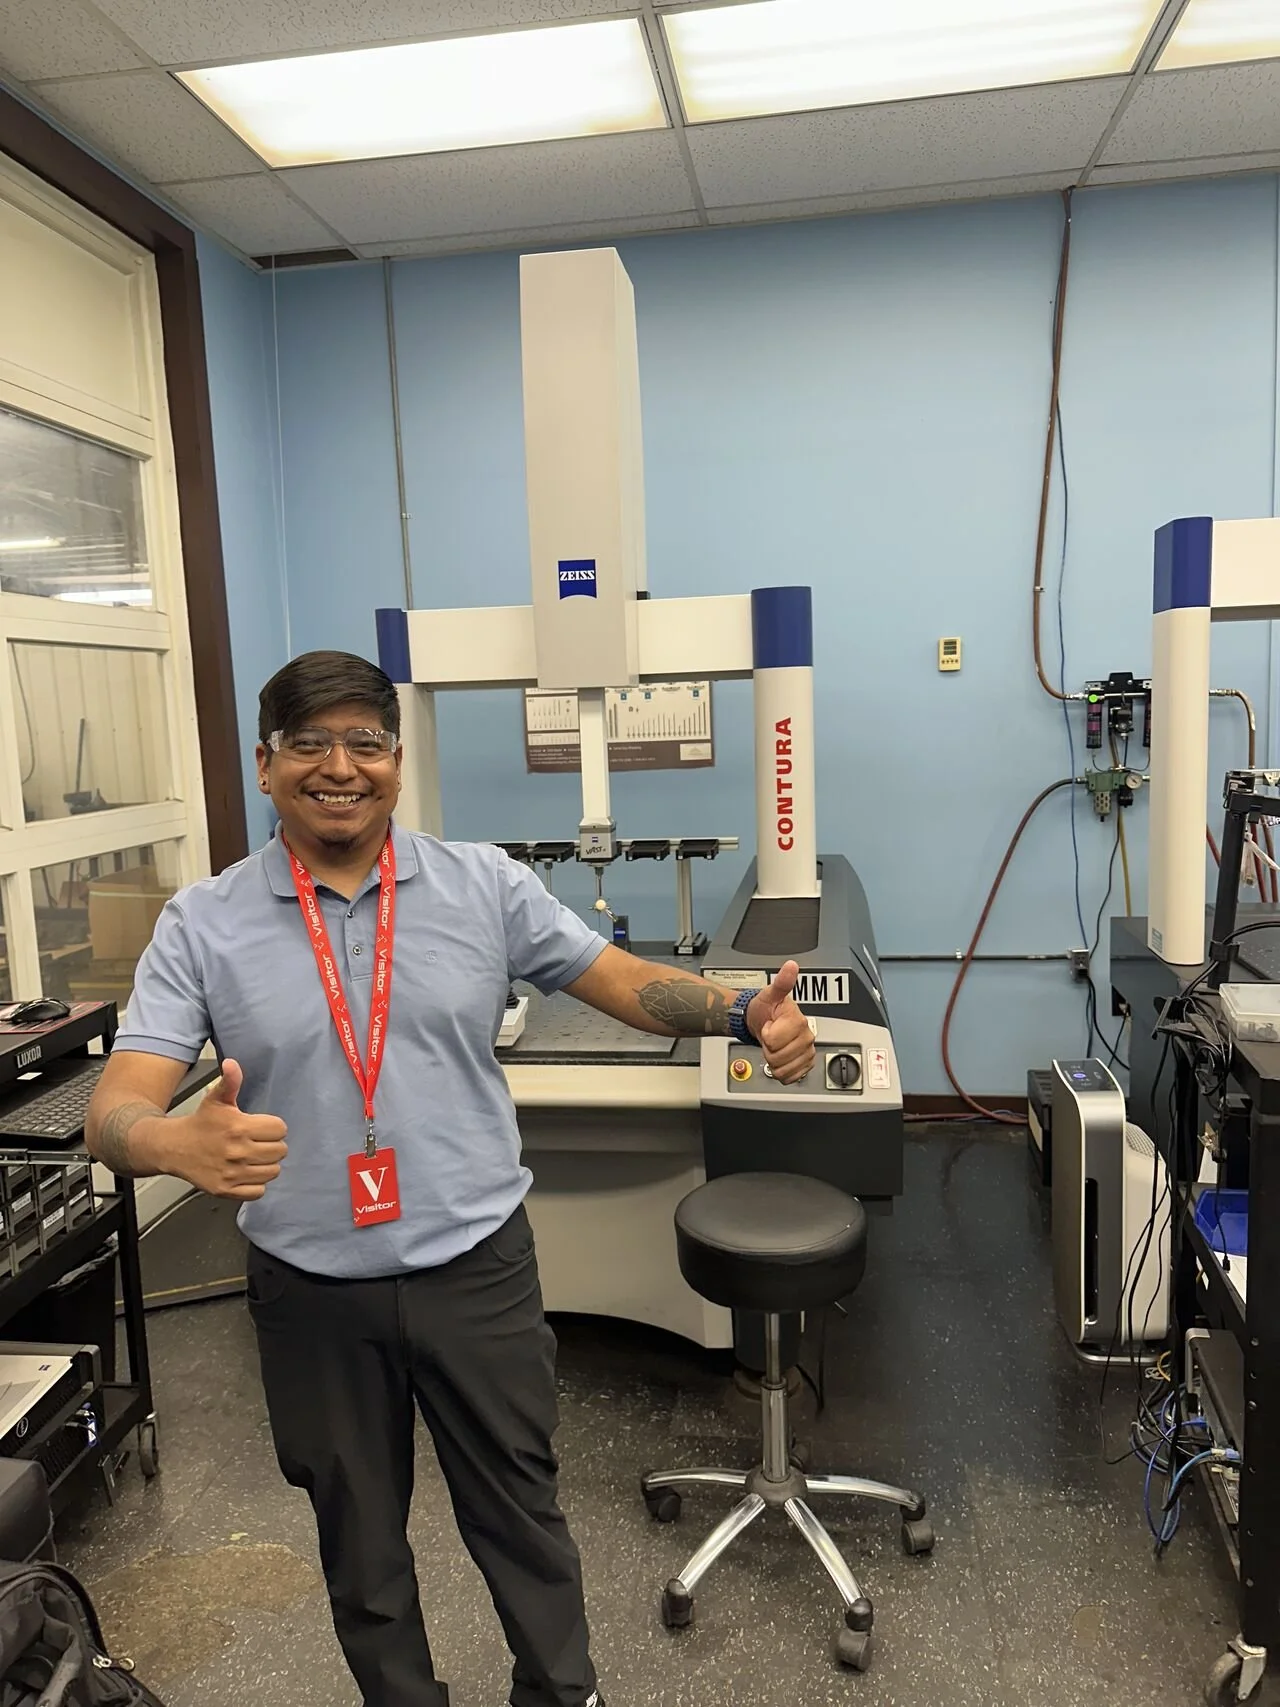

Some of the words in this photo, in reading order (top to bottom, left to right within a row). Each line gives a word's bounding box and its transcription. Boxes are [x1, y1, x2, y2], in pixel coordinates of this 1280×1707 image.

[560, 570, 595, 581] ZEISS
[776, 717, 794, 851] CONTURA
[382, 846, 390, 868] itor
[304, 892, 323, 937] Visitor
[381, 885, 391, 930] Visitor
[323, 953, 340, 1000] Visitor
[377, 948, 388, 995] Visitor
[793, 975, 828, 1002] MM
[834, 975, 844, 1002] 1
[16, 1045, 42, 1069] LUXOR
[341, 1017, 358, 1063] Visitor
[371, 1013, 383, 1062] Visitor
[356, 1166, 389, 1202] V
[355, 1201, 397, 1214] Visitor
